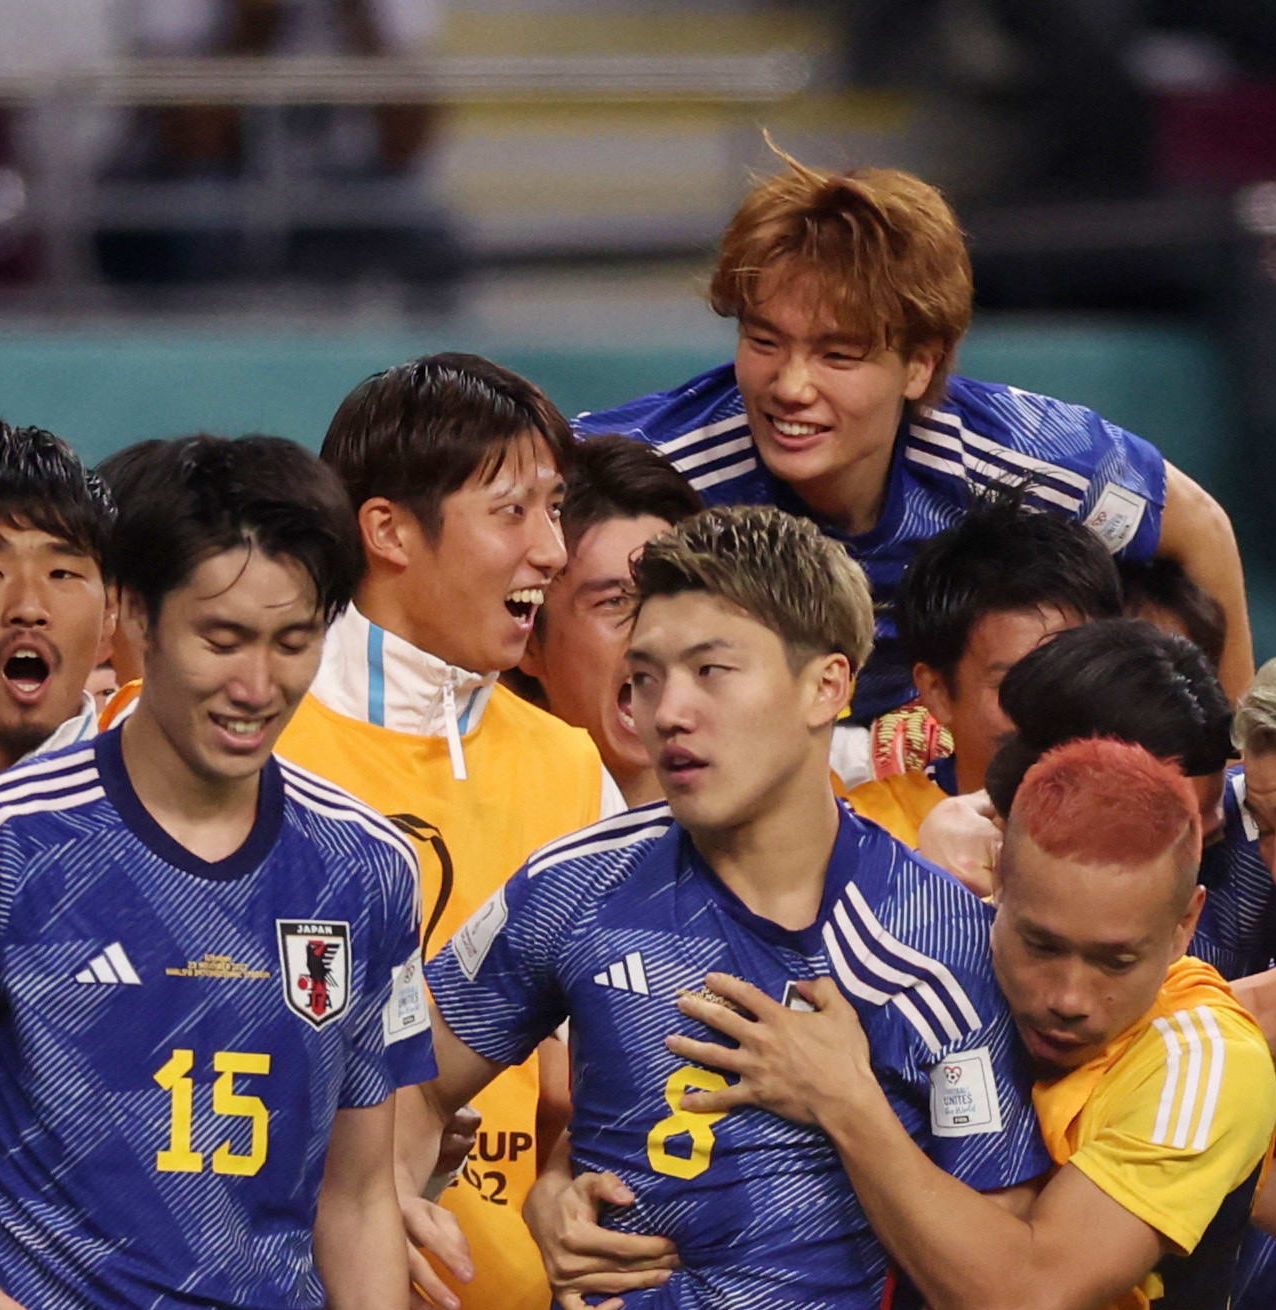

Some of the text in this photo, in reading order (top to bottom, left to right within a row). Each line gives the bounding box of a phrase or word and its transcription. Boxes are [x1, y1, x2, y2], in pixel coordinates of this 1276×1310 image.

[297, 924, 333, 934] JAPAN
[153, 1049, 272, 1177] 15
[468, 1131, 533, 1162] UP
[647, 1065, 730, 1180] 8
